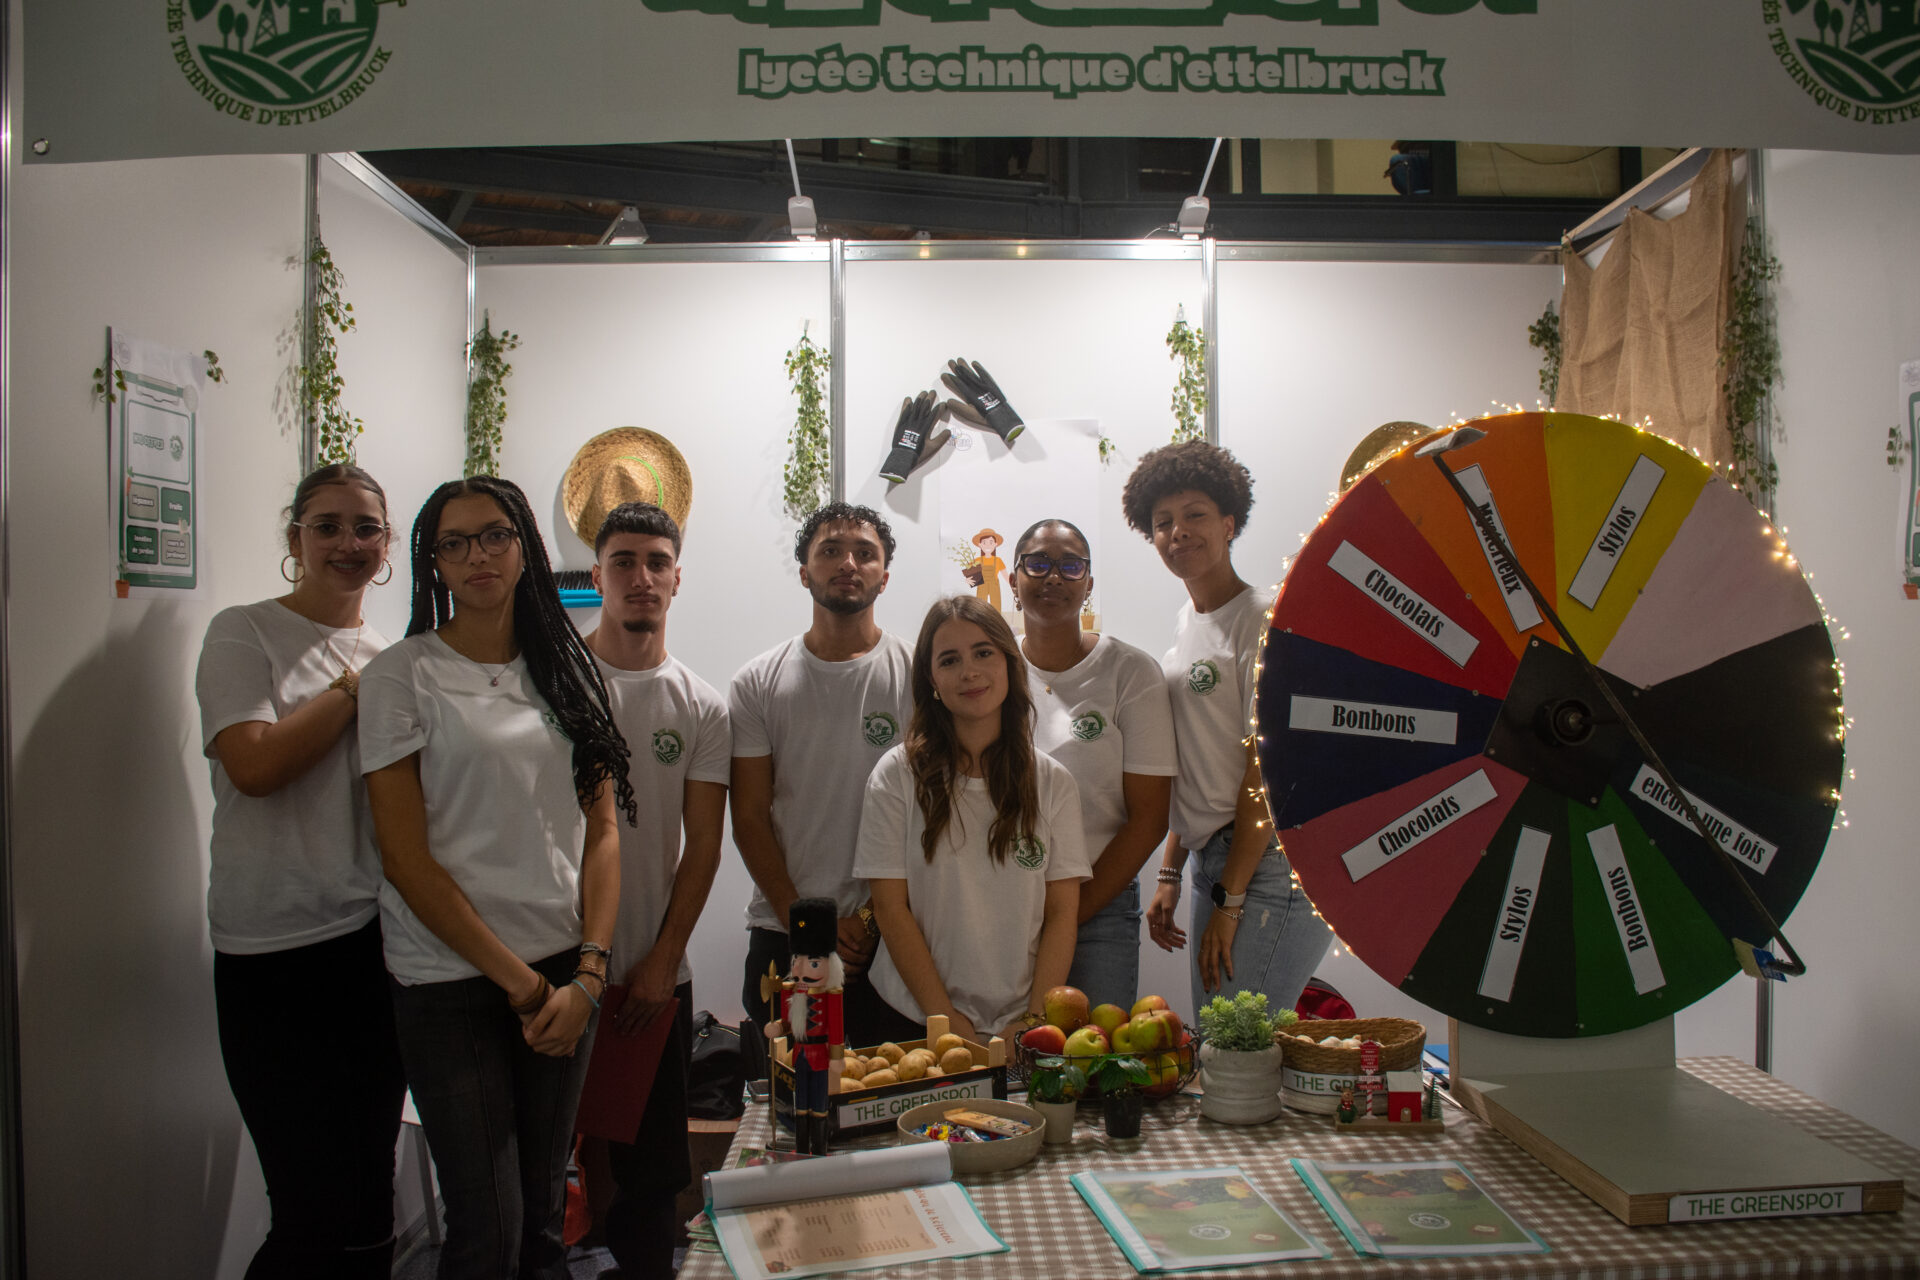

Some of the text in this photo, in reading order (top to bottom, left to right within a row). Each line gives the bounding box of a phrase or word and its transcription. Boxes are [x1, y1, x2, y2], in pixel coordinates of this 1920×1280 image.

[171, 35, 255, 122] TECHNIQUE
[256, 46, 394, 126] D'ETTELBRUCK
[738, 43, 1446, 100] lycée technique d'ettelbruck
[1768, 28, 1852, 118] TECHNIQUE
[1597, 505, 1637, 558] Stylos
[1364, 568, 1445, 638] Chocolats
[1331, 704, 1417, 735] Bonbons
[1377, 795, 1461, 856] Chocolats
[1702, 811, 1733, 844] une
[1732, 831, 1766, 865] fois
[1499, 886, 1533, 943] Stylos
[1606, 866, 1649, 953] Bonbons
[1293, 1074, 1325, 1092] THE
[853, 1104, 886, 1124] THE
[1687, 1192, 1845, 1217] THE GREENSPOT
